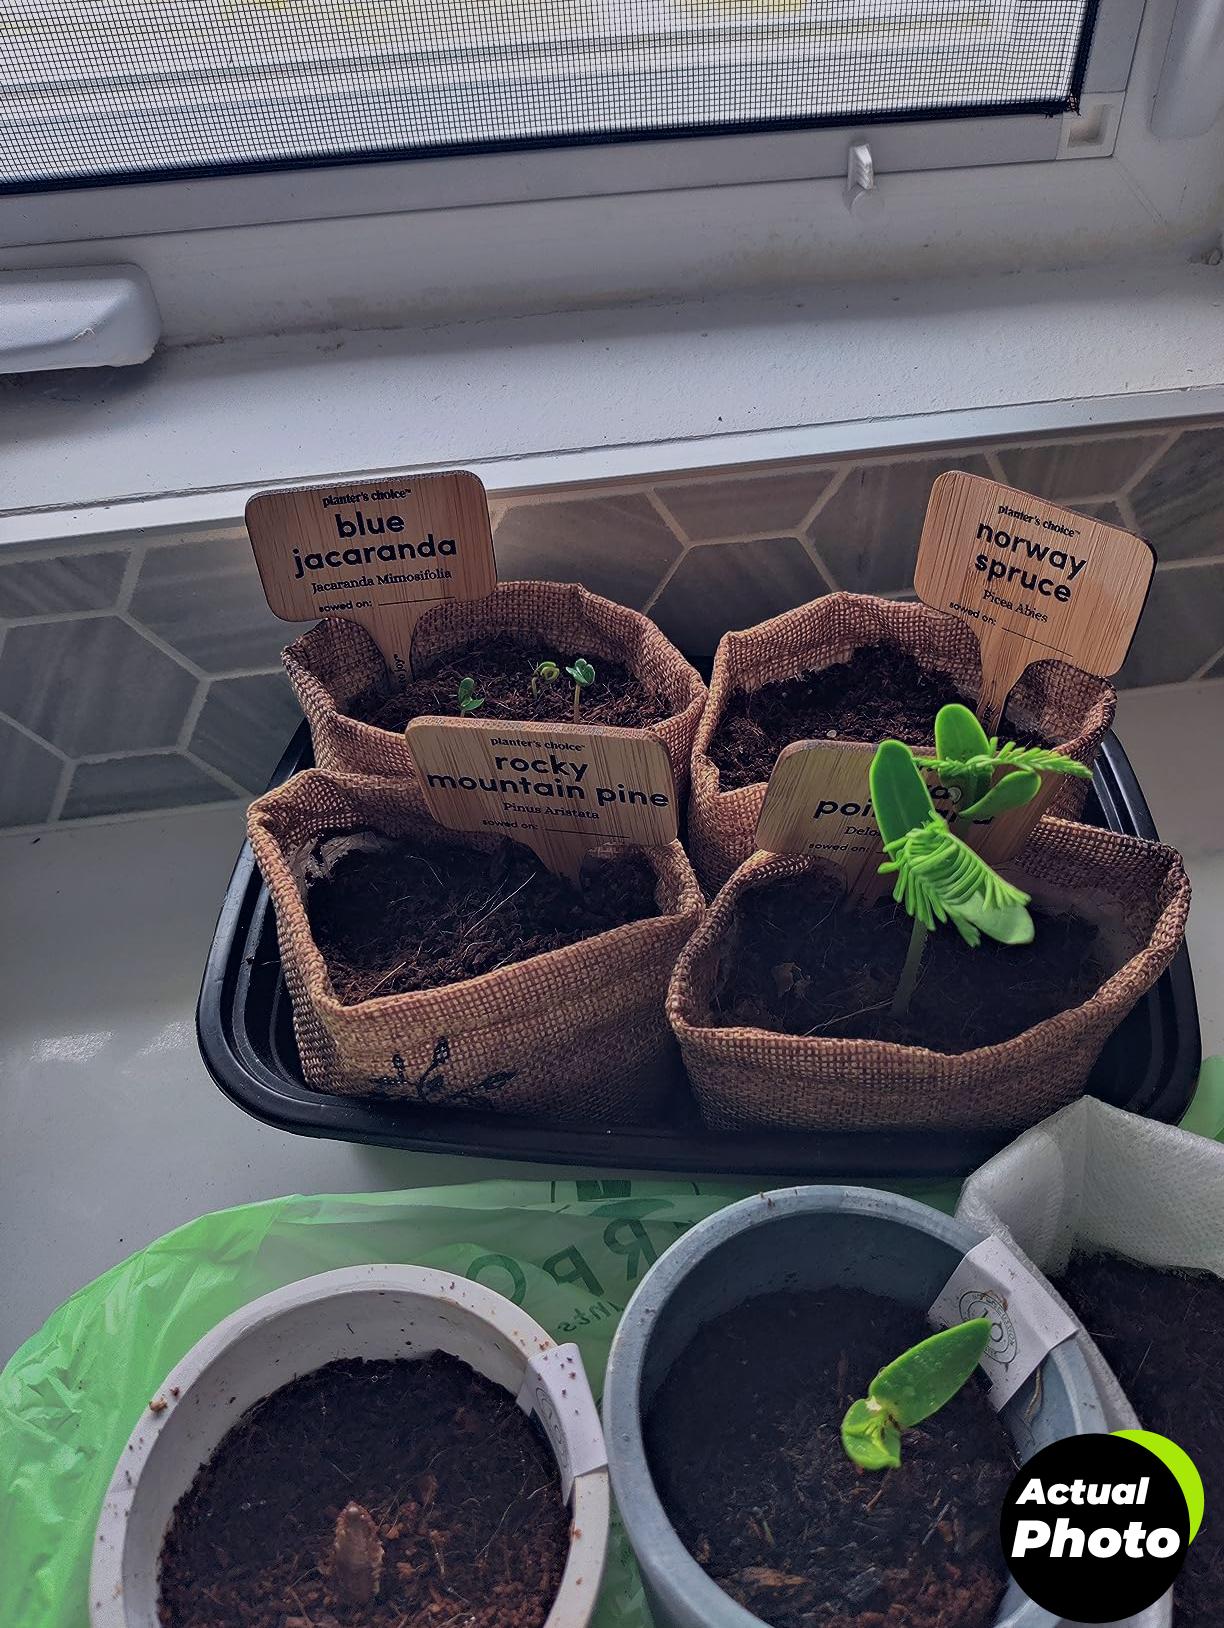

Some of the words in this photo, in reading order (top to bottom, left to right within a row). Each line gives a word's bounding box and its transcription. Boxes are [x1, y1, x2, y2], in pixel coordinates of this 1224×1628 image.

[322, 491, 369, 508] planter's
[335, 511, 405, 538] blue
[998, 505, 1040, 526] planter's
[292, 534, 457, 579] jacaranda
[976, 523, 1087, 580] norway
[311, 576, 375, 594] Jacaranda
[376, 569, 452, 585] Mimosifolia
[975, 554, 1071, 602] spruce
[319, 601, 353, 612] sowed
[356, 600, 372, 608] on:
[949, 602, 980, 618] sowed
[981, 614, 997, 625] on:
[982, 589, 1013, 611] Picea
[1015, 604, 1048, 623] Abies
[490, 738, 541, 748] planter's
[495, 754, 588, 782] rocky
[427, 774, 585, 799] mountain
[596, 784, 669, 807] pine
[502, 802, 541, 814] Pinus
[544, 806, 599, 819] Aristata
[483, 820, 518, 828] sowed
[809, 843, 848, 851] sowed
